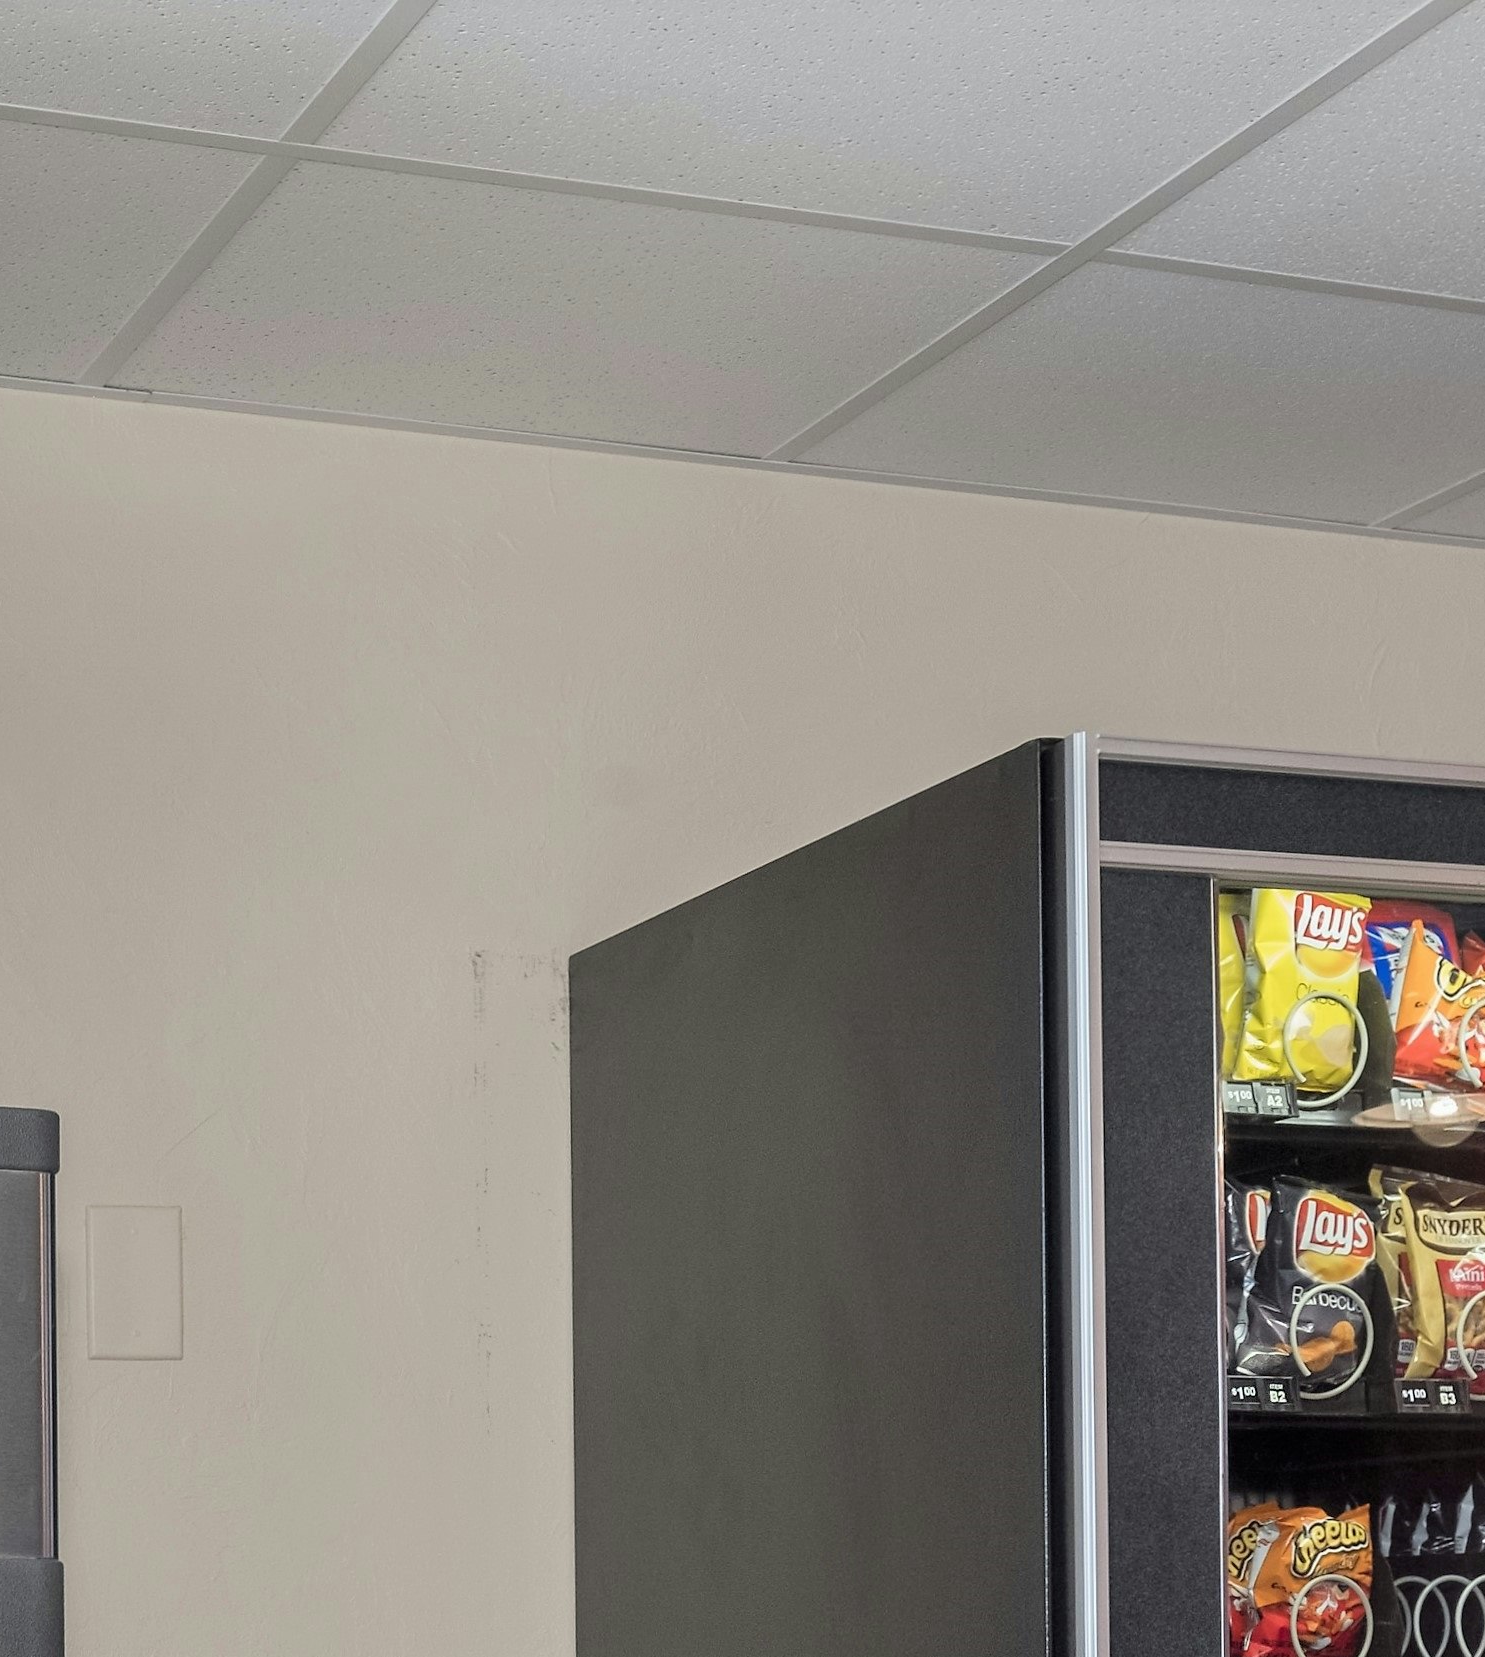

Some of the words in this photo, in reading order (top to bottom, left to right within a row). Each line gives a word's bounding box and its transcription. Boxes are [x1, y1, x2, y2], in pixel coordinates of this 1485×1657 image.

[1296, 893, 1366, 950] Lay's
[1267, 1094, 1282, 1107] A2
[1300, 1200, 1369, 1256] Lay's
[1270, 1391, 1287, 1403] B2
[1440, 1393, 1456, 1405] B3
